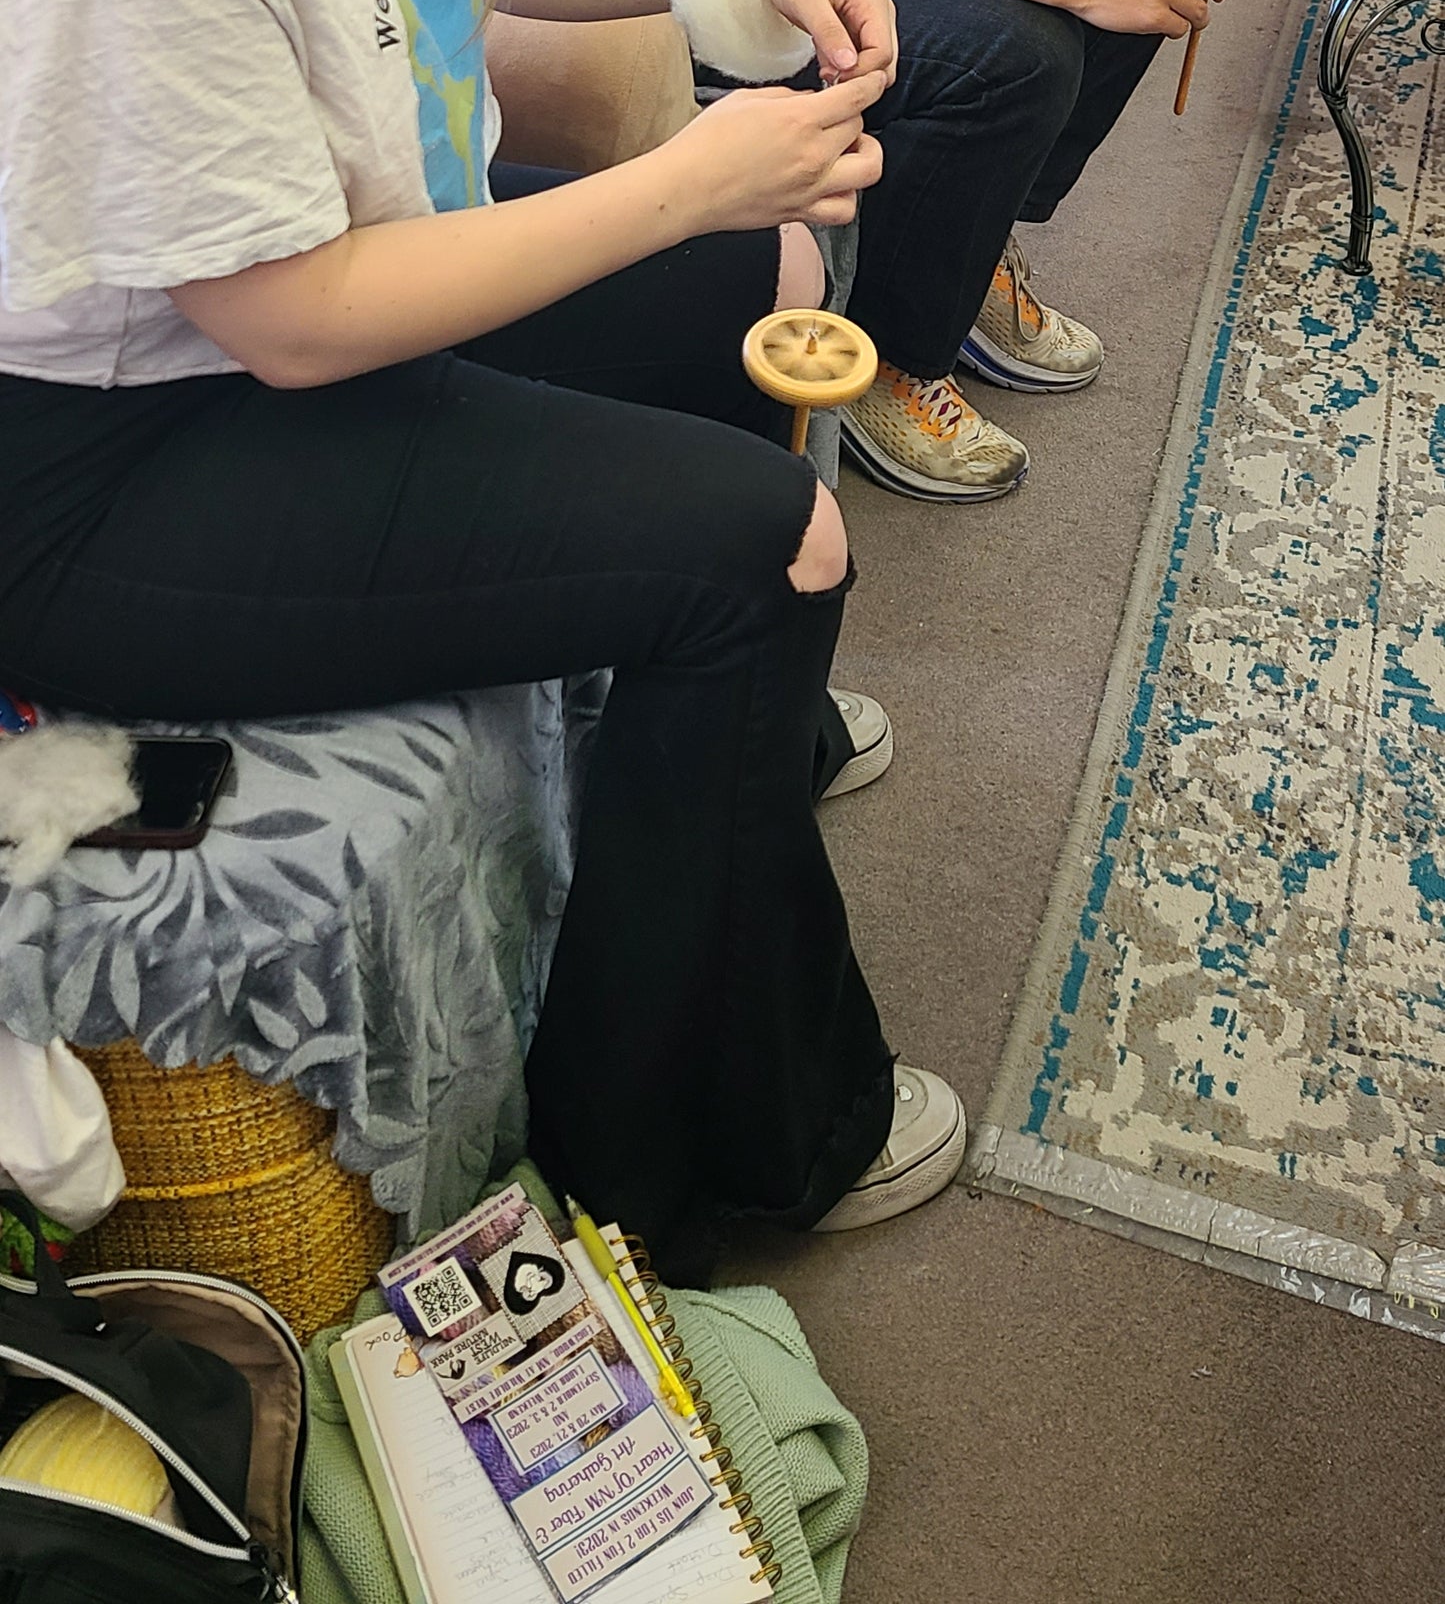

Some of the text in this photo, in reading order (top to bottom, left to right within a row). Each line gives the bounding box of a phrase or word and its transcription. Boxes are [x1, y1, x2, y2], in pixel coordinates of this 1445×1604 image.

[431, 1328, 488, 1368] NATURE PARK
[470, 1332, 501, 1357] WEST
[474, 1337, 516, 1364] WILDLIFE
[466, 1397, 488, 1414] WEST
[540, 1407, 549, 1416] &
[550, 1401, 557, 1411] 2
[506, 1419, 530, 1439] 2023
[568, 1423, 576, 1433] &
[576, 1414, 589, 1428] 20
[530, 1438, 553, 1458] 2023
[633, 1442, 674, 1471] Heart
[544, 1437, 635, 1502] Art Gathering
[613, 1473, 634, 1493] Of
[585, 1486, 615, 1511] NM
[551, 1506, 585, 1532] Fiber
[536, 1528, 548, 1543] &
[574, 1529, 608, 1558] 2023!
[624, 1534, 636, 1549] 2
